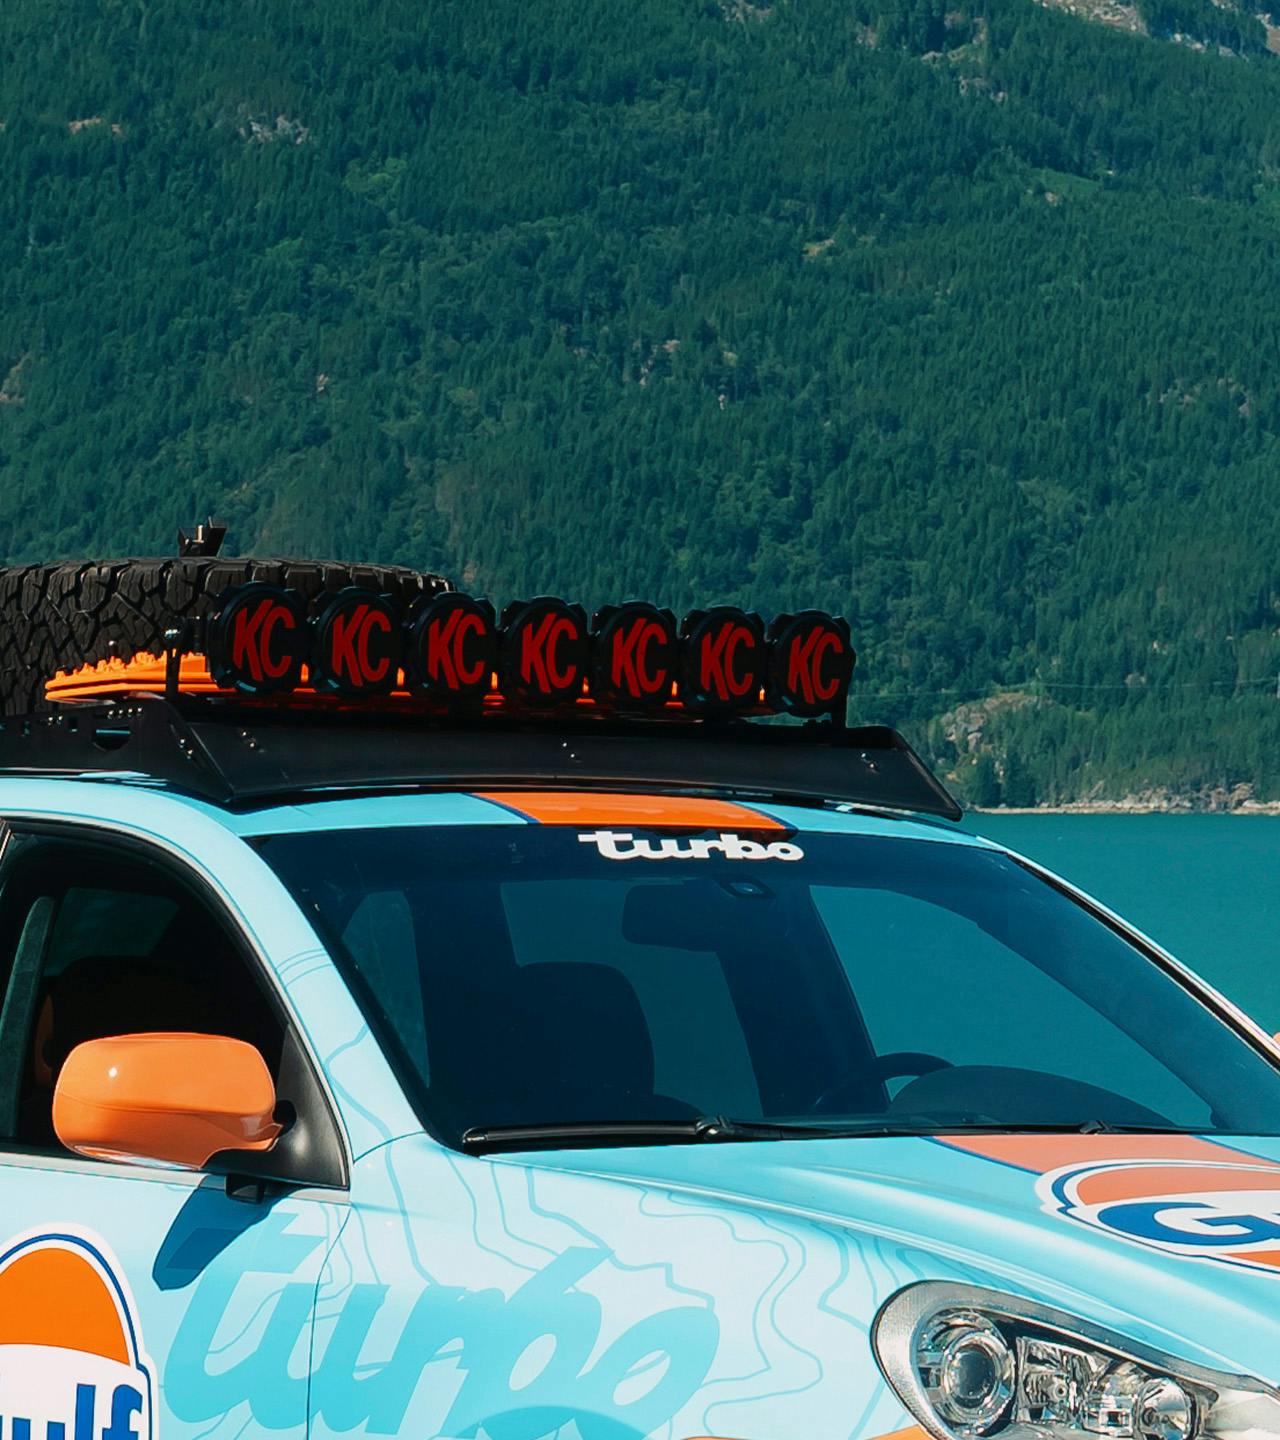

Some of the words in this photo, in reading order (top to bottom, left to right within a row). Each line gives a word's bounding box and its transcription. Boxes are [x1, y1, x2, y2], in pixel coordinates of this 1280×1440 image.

[232, 598, 296, 682] KC
[331, 603, 392, 687] KC
[427, 608, 486, 690] KC
[520, 612, 579, 695] KC
[610, 617, 668, 699] KC
[700, 622, 756, 702] KC
[787, 626, 843, 704] KC
[578, 830, 804, 861] turbo
